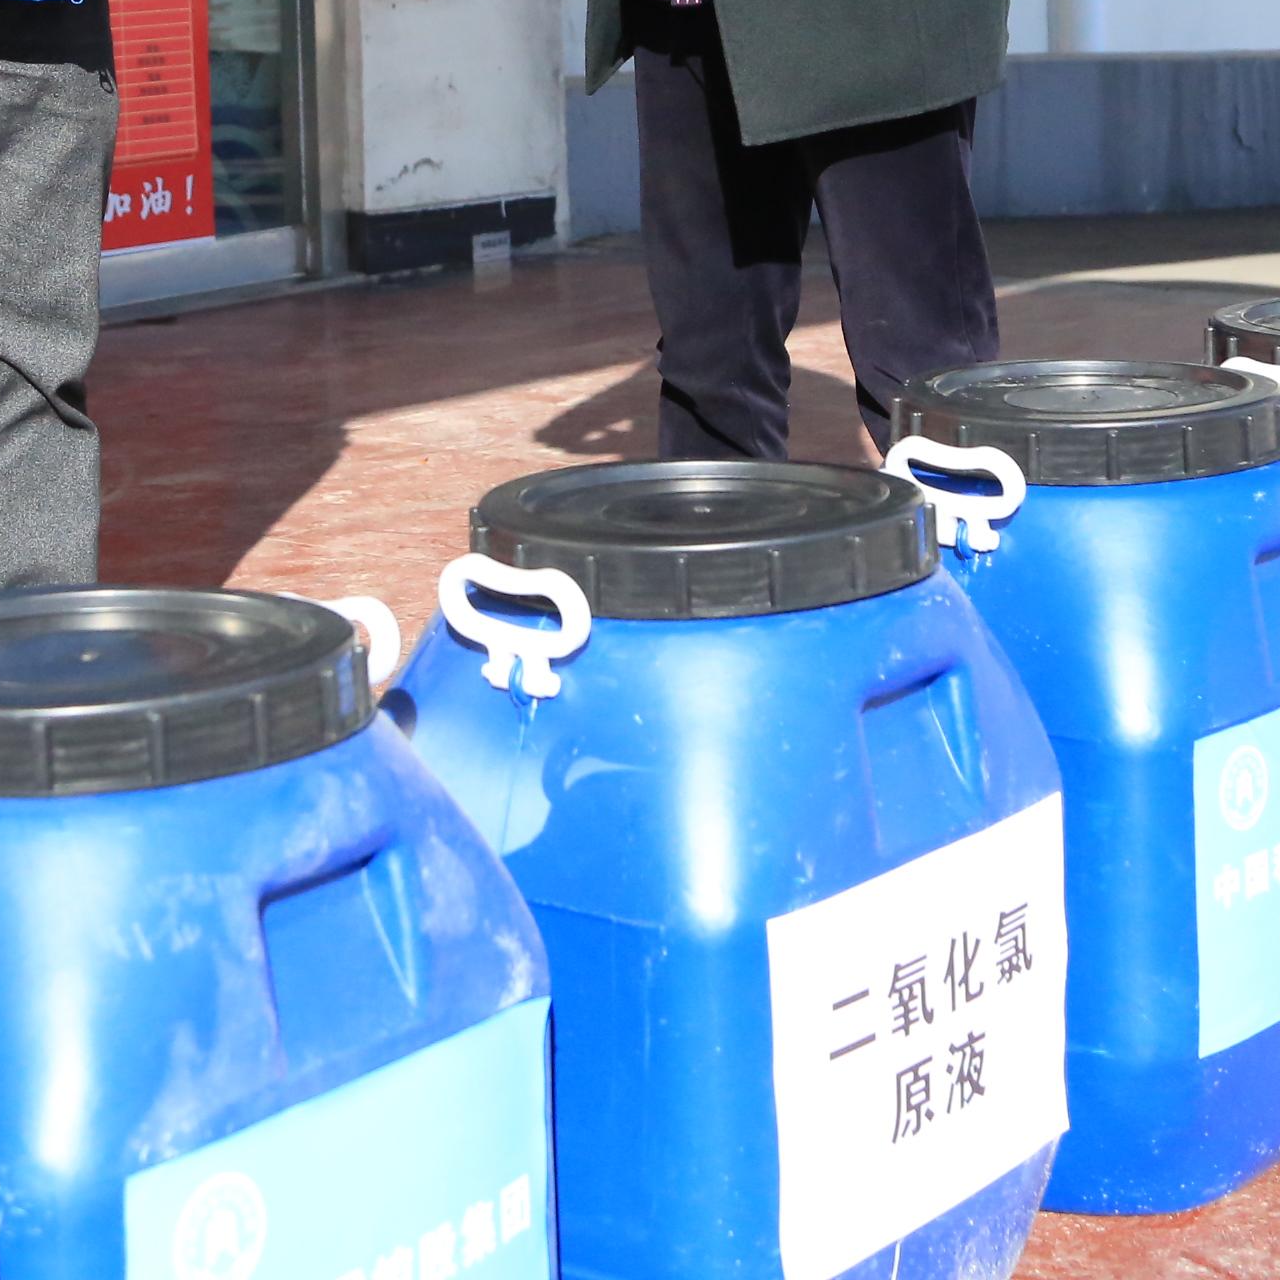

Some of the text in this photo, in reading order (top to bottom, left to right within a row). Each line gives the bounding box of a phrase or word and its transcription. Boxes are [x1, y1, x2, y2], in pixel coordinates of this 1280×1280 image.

[829, 903, 1033, 1061] 二氧化氯
[891, 1031, 987, 1143] 原液
